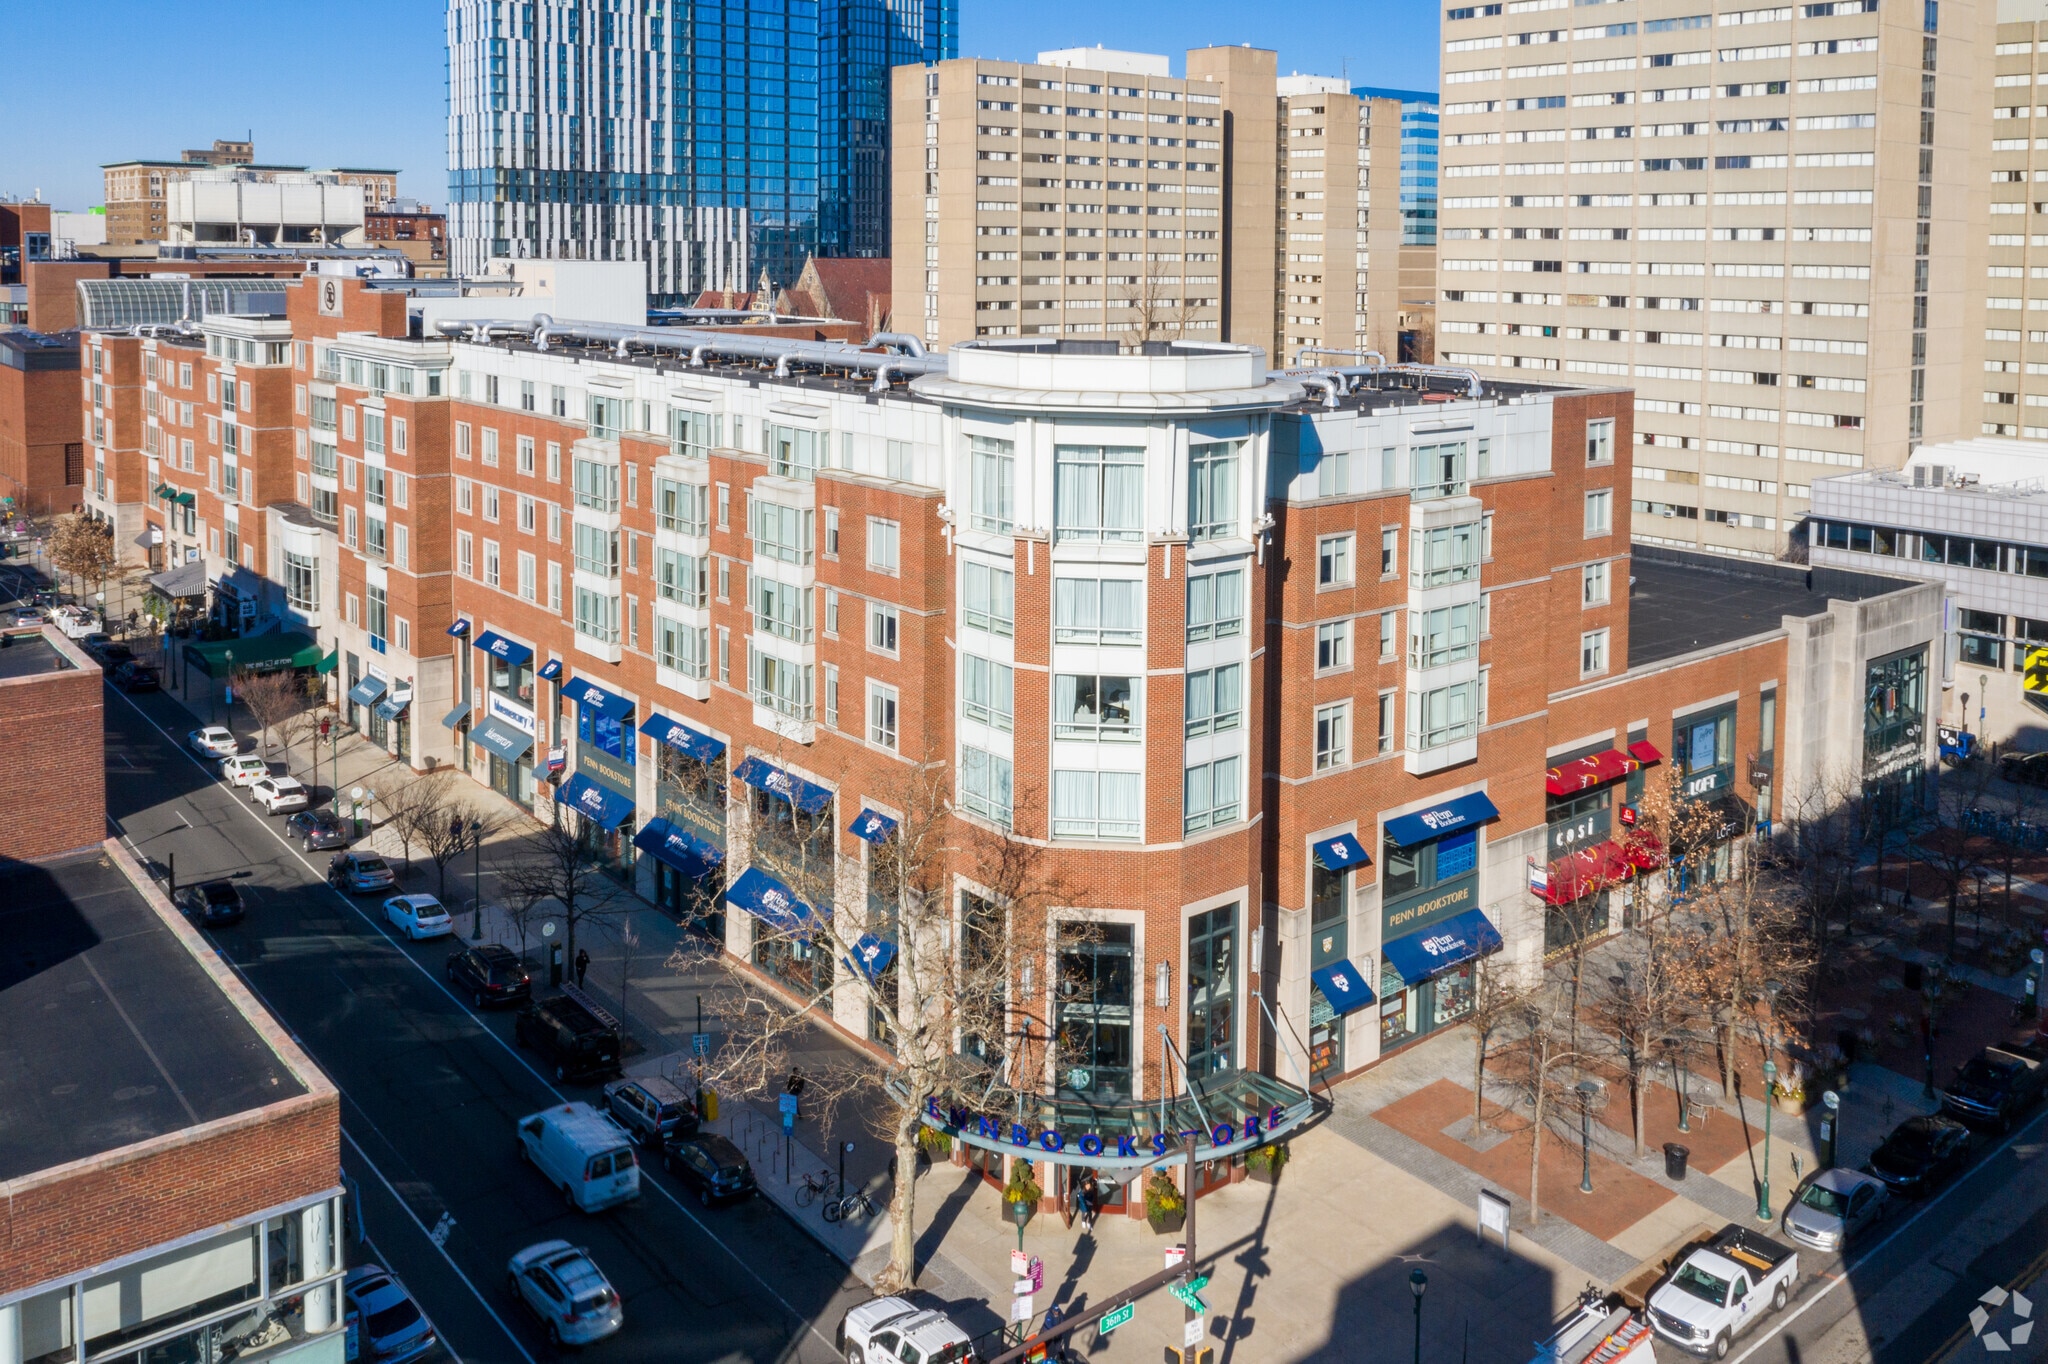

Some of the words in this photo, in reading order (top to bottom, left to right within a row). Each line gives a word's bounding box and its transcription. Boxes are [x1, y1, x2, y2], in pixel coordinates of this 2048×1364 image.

[485, 728, 514, 750] bluemercury
[584, 756, 598, 770] PENN
[600, 764, 632, 788] BOOKSTORE
[1690, 774, 1717, 796] LOFT
[666, 798, 682, 815] PENN
[684, 808, 720, 836] BOOKSTORE
[1431, 810, 1454, 822] Penn
[1438, 815, 1466, 828] Bookstore
[1716, 822, 1736, 840] LOFT
[1389, 908, 1414, 927] PENN
[1417, 888, 1469, 916] BOOKSTORE
[1432, 935, 1454, 947] Penn
[1438, 940, 1466, 954] Bookstore
[1106, 1314, 1121, 1328] 36th
[1122, 1309, 1129, 1320] St
